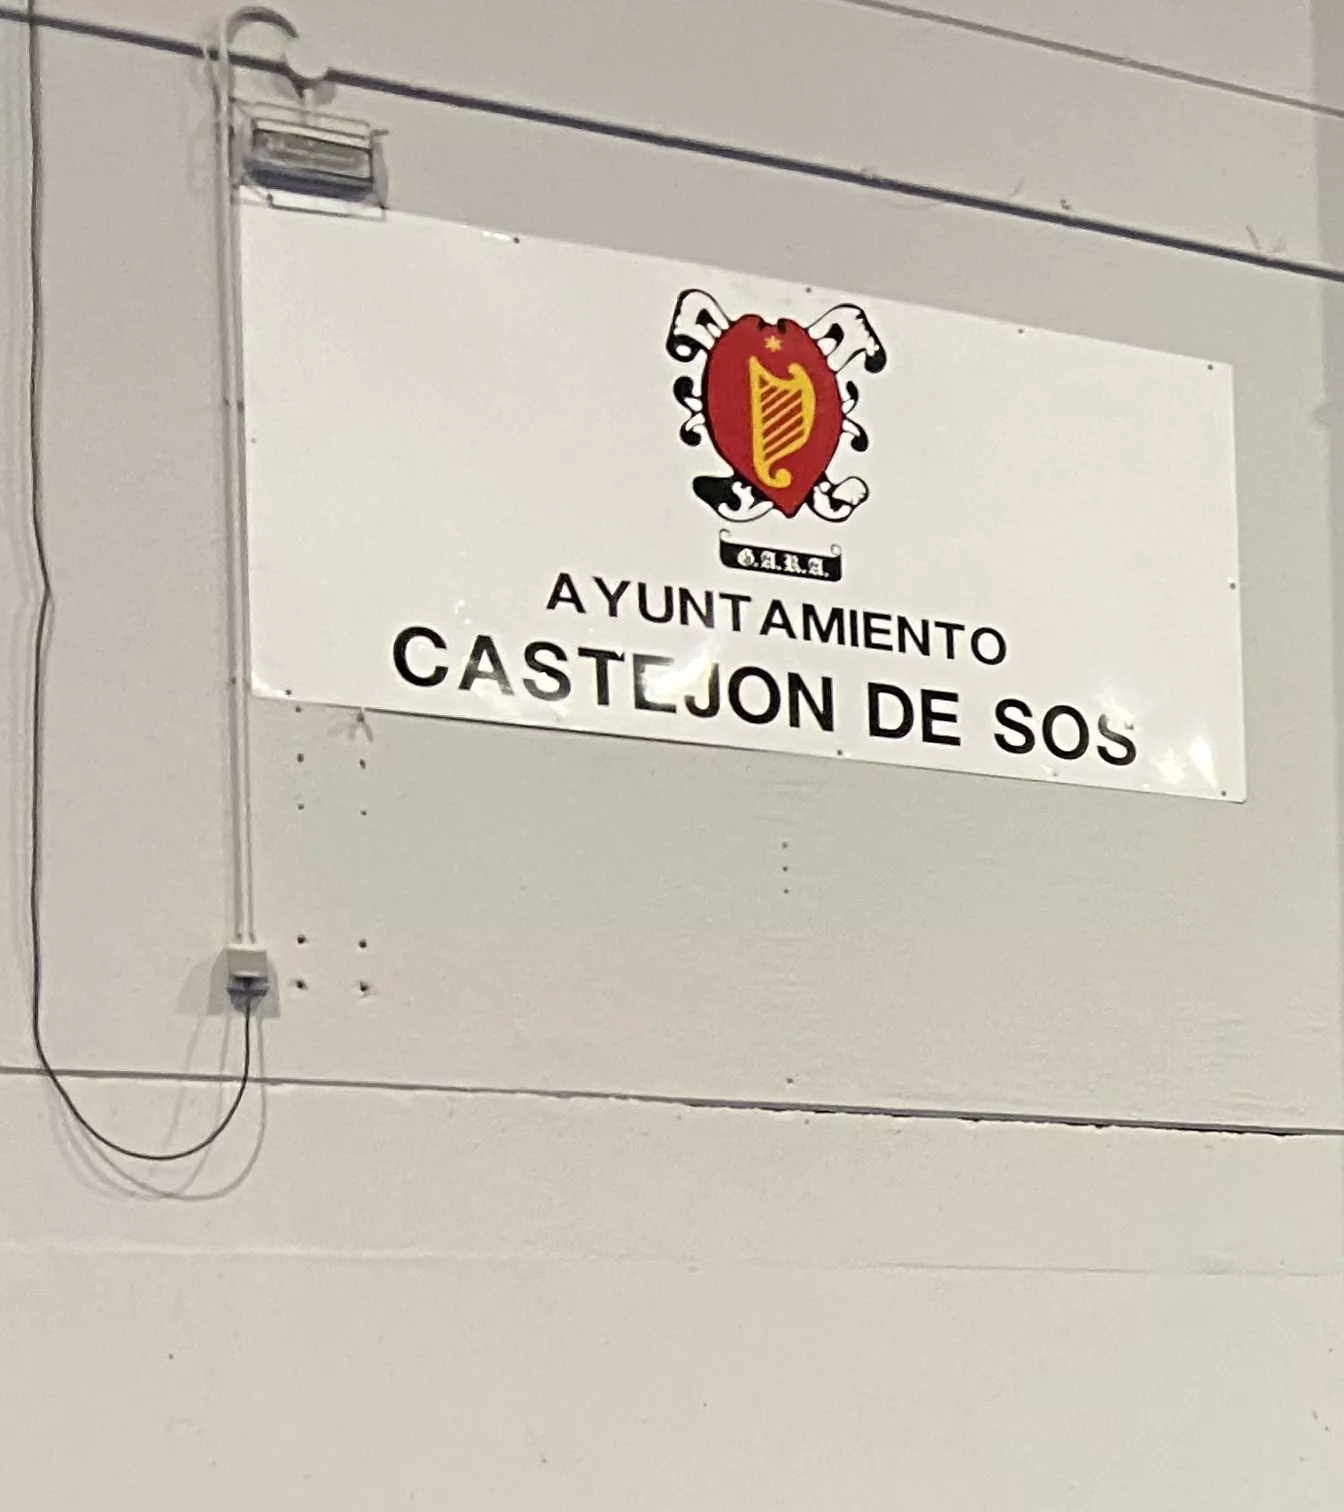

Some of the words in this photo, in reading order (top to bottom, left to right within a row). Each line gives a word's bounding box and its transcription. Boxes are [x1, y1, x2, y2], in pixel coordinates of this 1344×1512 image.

[545, 573, 1007, 666] AYUNTAMIENTO
[393, 626, 835, 732] CASTEJON
[867, 681, 961, 747] DE
[994, 698, 1137, 766] SOS
